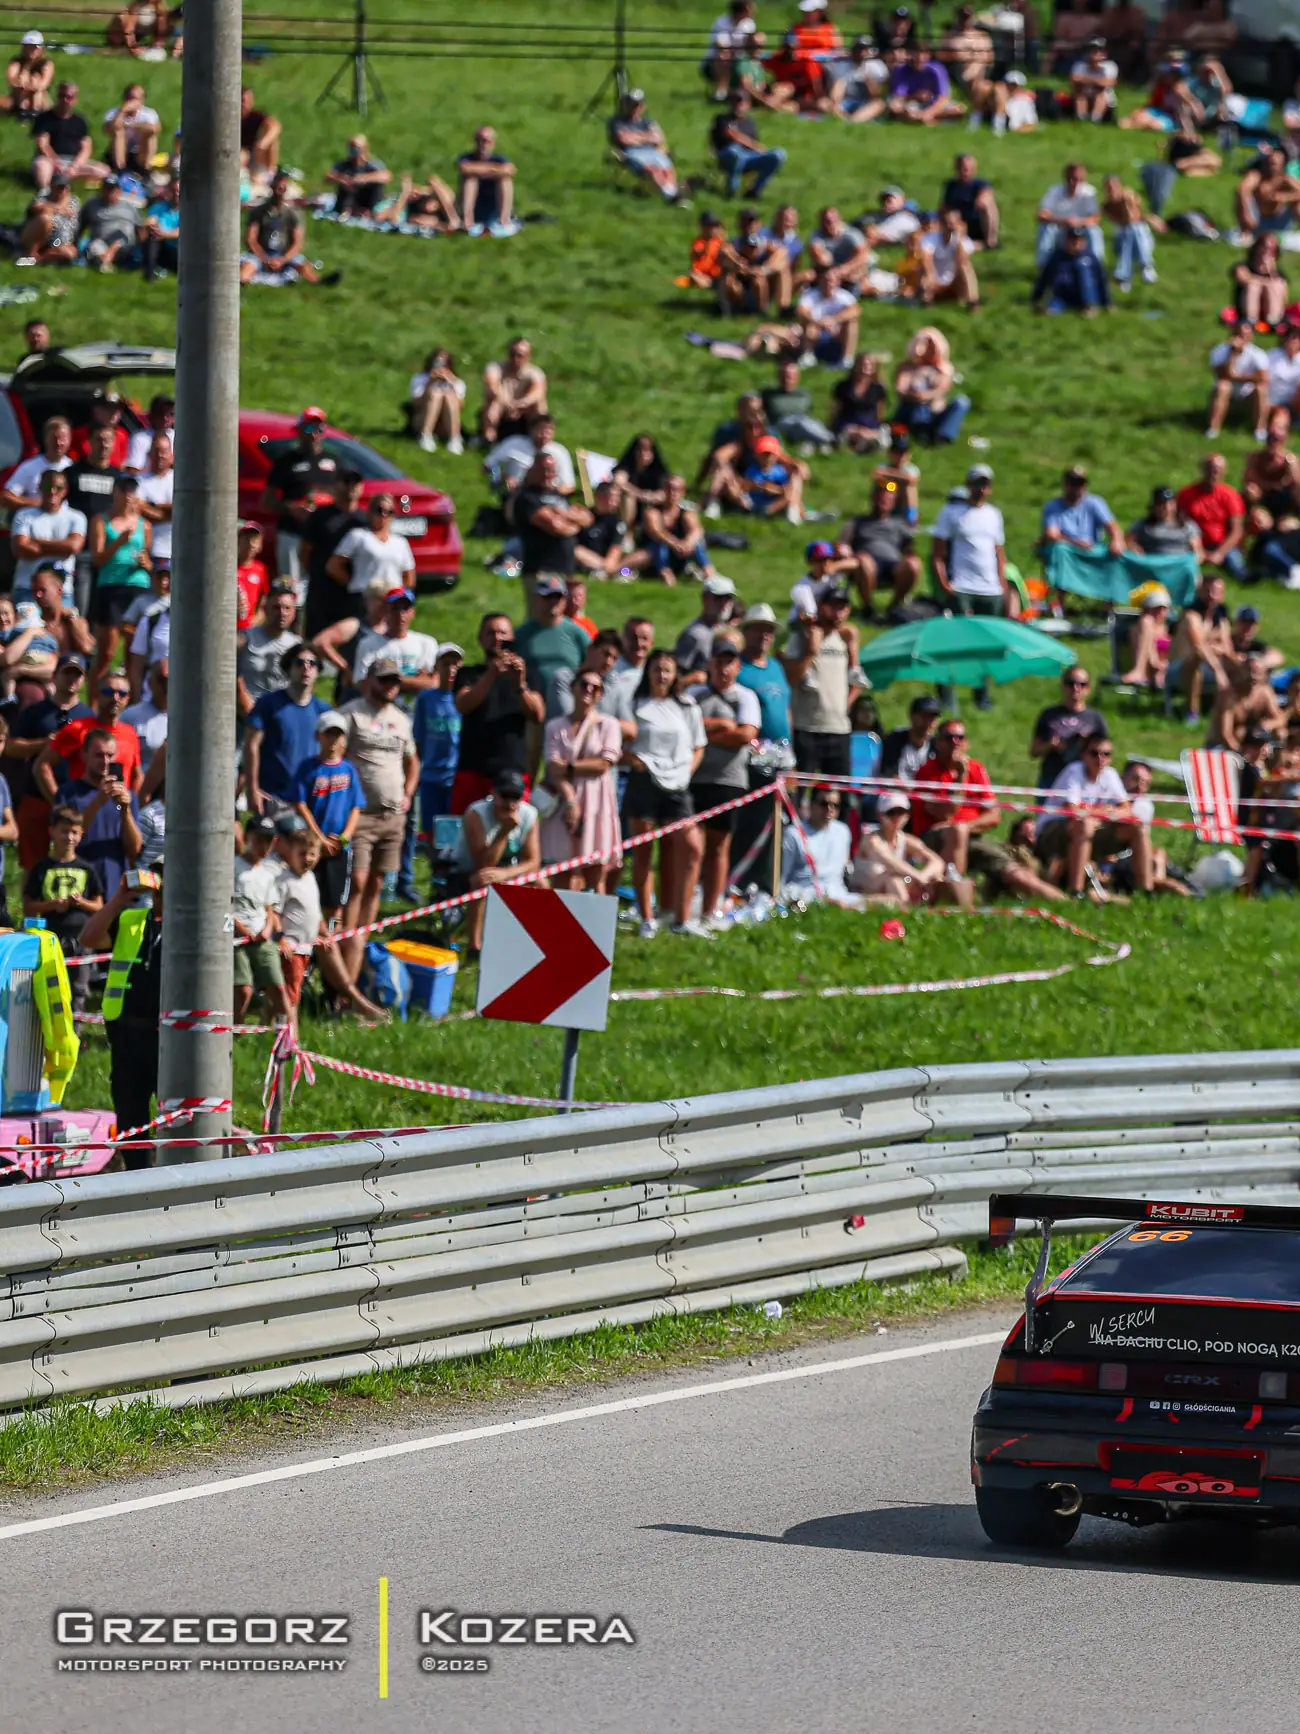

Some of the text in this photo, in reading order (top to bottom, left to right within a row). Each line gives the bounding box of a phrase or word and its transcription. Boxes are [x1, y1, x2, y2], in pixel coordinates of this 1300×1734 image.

[1151, 1205, 1235, 1218] KUBIT
[1150, 1214, 1242, 1223] MOTORSPORT
[1128, 1230, 1193, 1242] 66
[1117, 1335, 1164, 1349] DACHU
[1167, 1338, 1201, 1353] CLIO,
[1205, 1341, 1234, 1353] POD
[1237, 1343, 1279, 1358] NOGĄ
[1164, 1374, 1221, 1386] CRX
